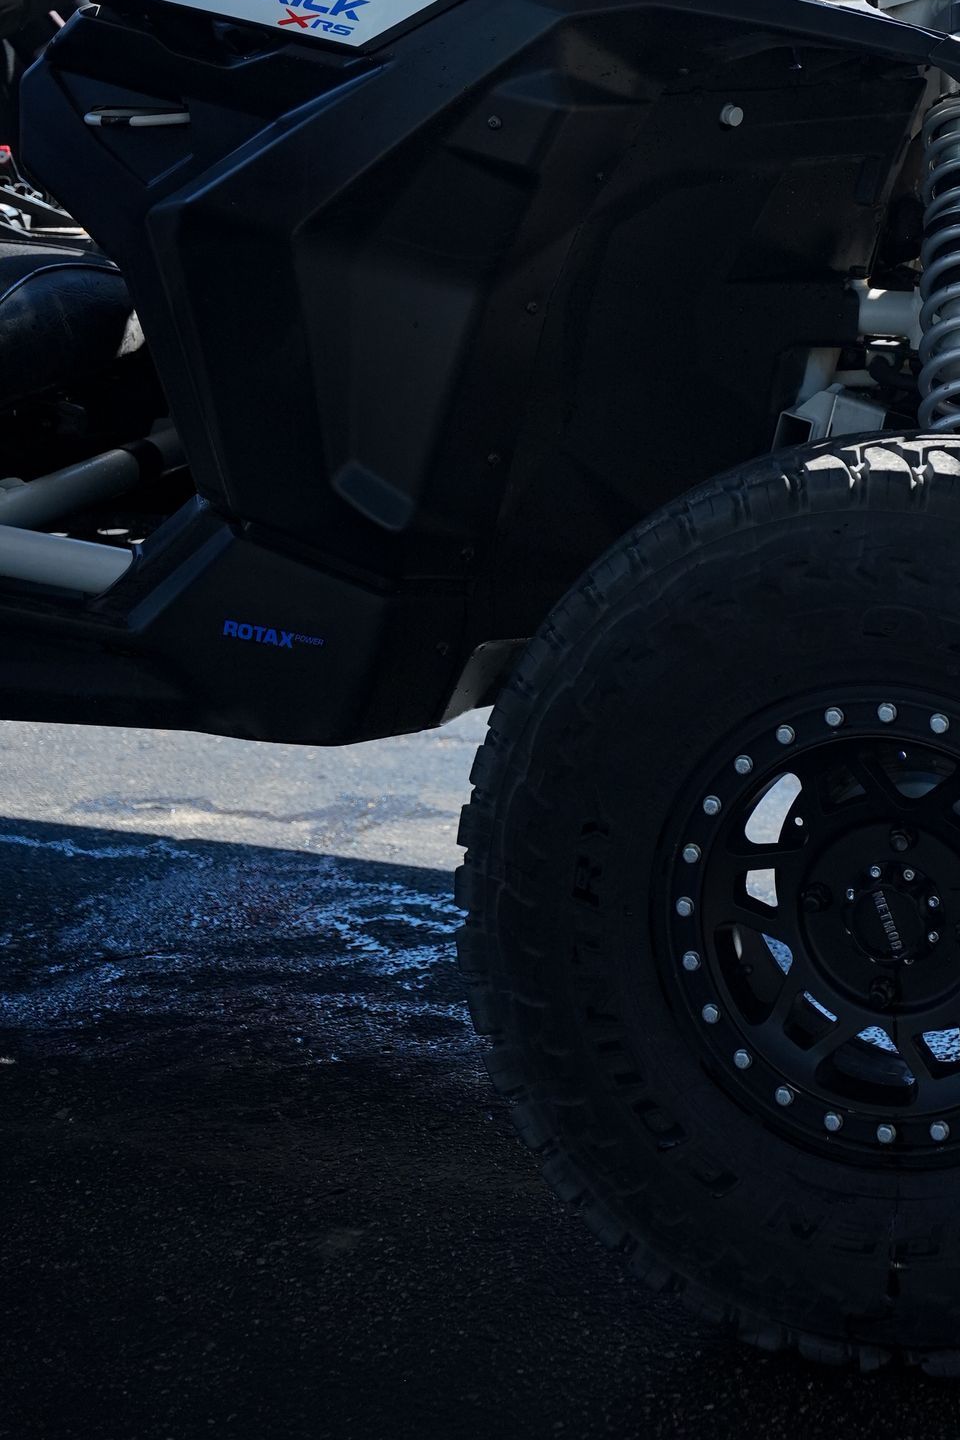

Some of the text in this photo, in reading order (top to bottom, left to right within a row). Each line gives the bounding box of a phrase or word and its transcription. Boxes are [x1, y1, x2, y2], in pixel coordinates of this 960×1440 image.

[223, 619, 326, 649] ROTAX POWER
[872, 890, 903, 951] METHOD
